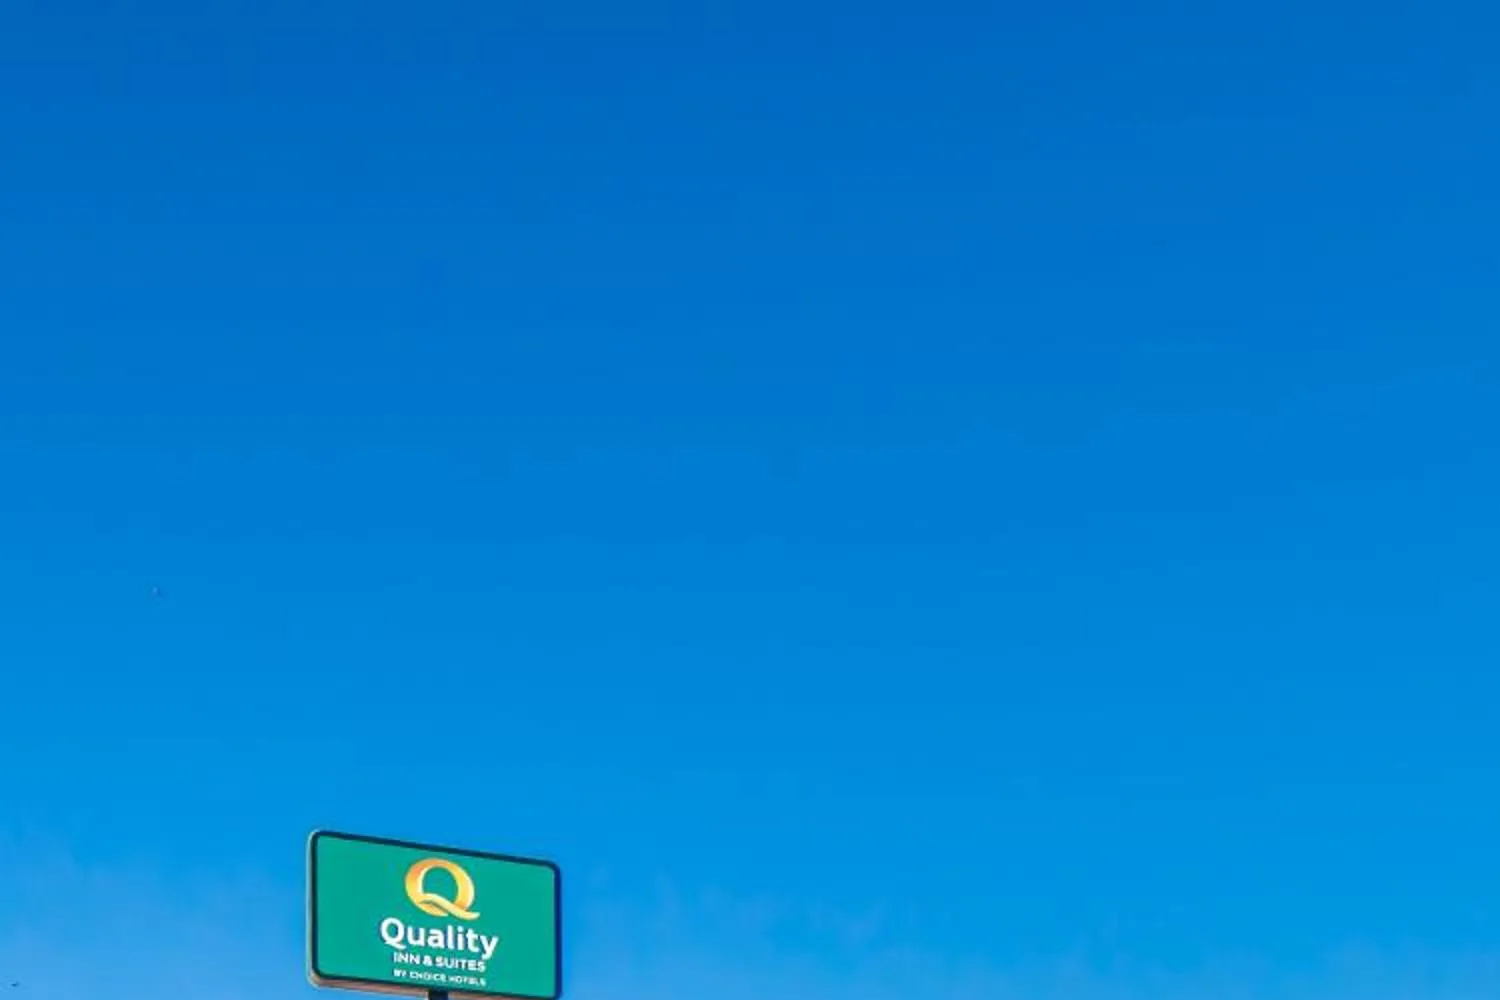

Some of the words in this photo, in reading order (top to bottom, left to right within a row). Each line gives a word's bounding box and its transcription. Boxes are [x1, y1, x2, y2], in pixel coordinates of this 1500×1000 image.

[381, 917, 499, 960] Quality
[393, 951, 421, 965] INN
[422, 955, 433, 967] &
[435, 955, 486, 973] SUITES
